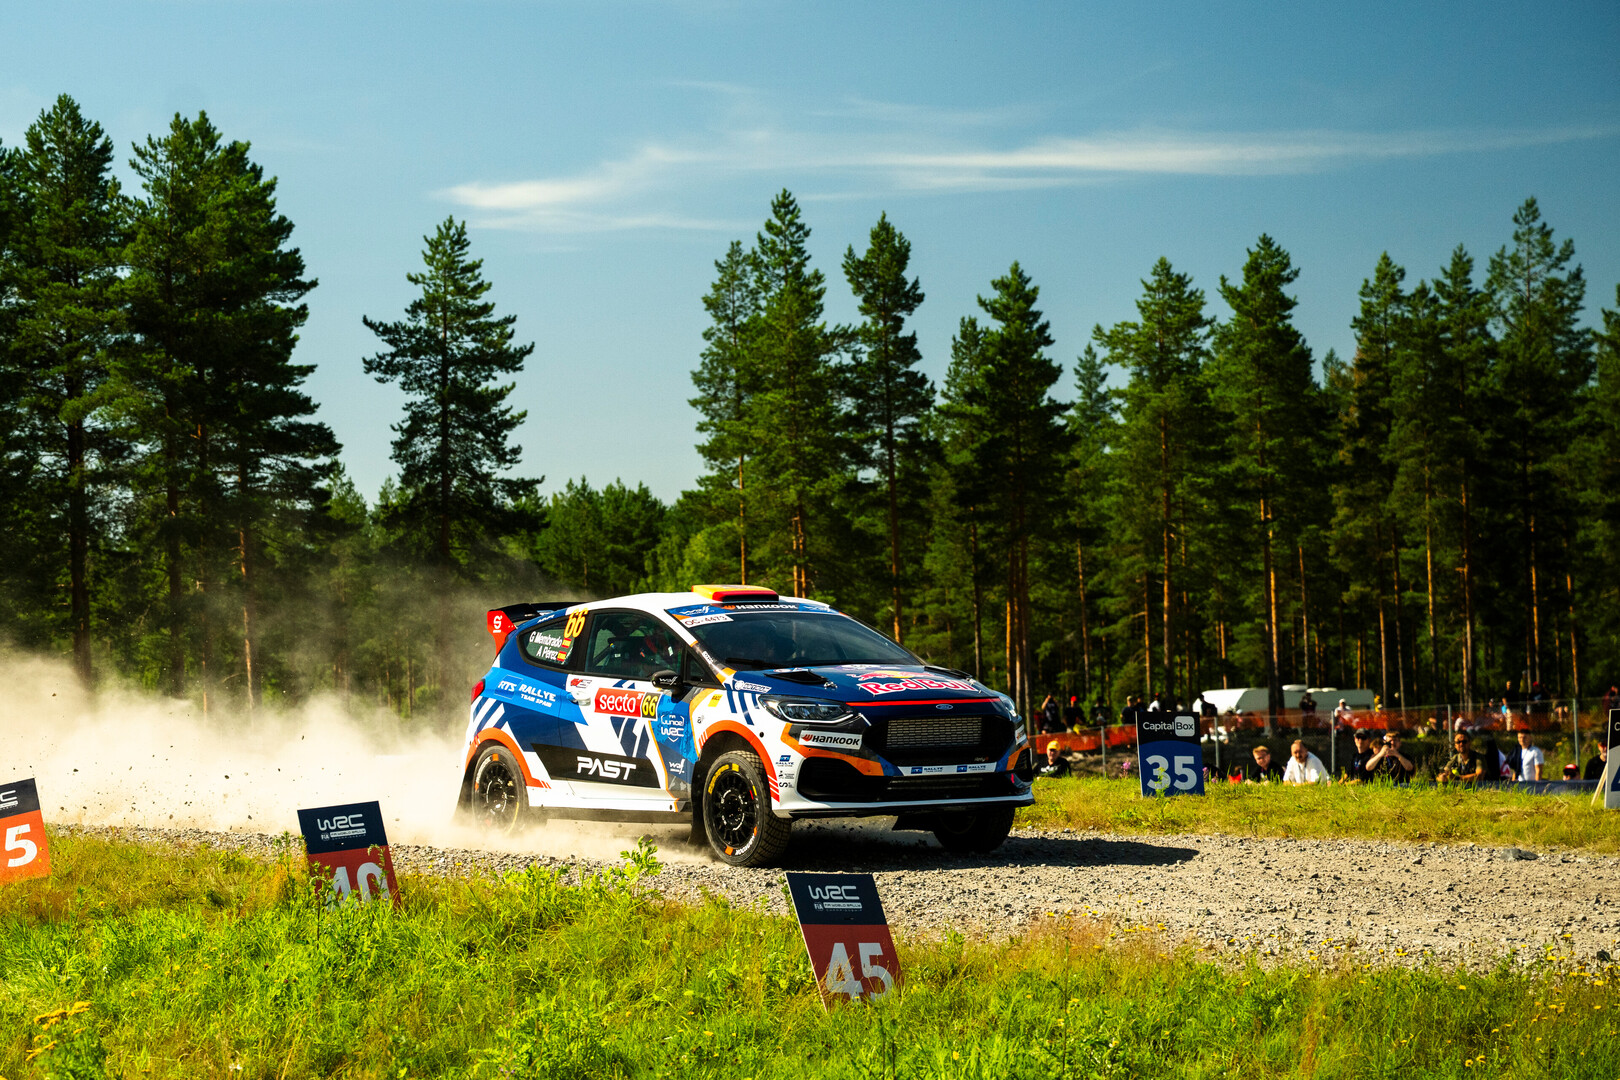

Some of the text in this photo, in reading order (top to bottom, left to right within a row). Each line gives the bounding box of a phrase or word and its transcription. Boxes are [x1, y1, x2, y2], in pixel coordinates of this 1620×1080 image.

[563, 608, 589, 638] 66
[529, 631, 563, 648] G Membrado
[536, 646, 559, 660] A Pérez
[497, 680, 518, 692] RTS
[519, 684, 557, 702] RALLYE
[857, 679, 979, 695] Red Bull
[600, 693, 636, 713] secto
[642, 695, 658, 716] 66
[661, 727, 684, 737] WRC
[577, 756, 637, 780] PAST
[1146, 755, 1197, 790] 35
[317, 813, 365, 831] WRC
[5, 823, 38, 867] 5
[808, 885, 860, 900] WRC
[825, 942, 894, 1004] 45
